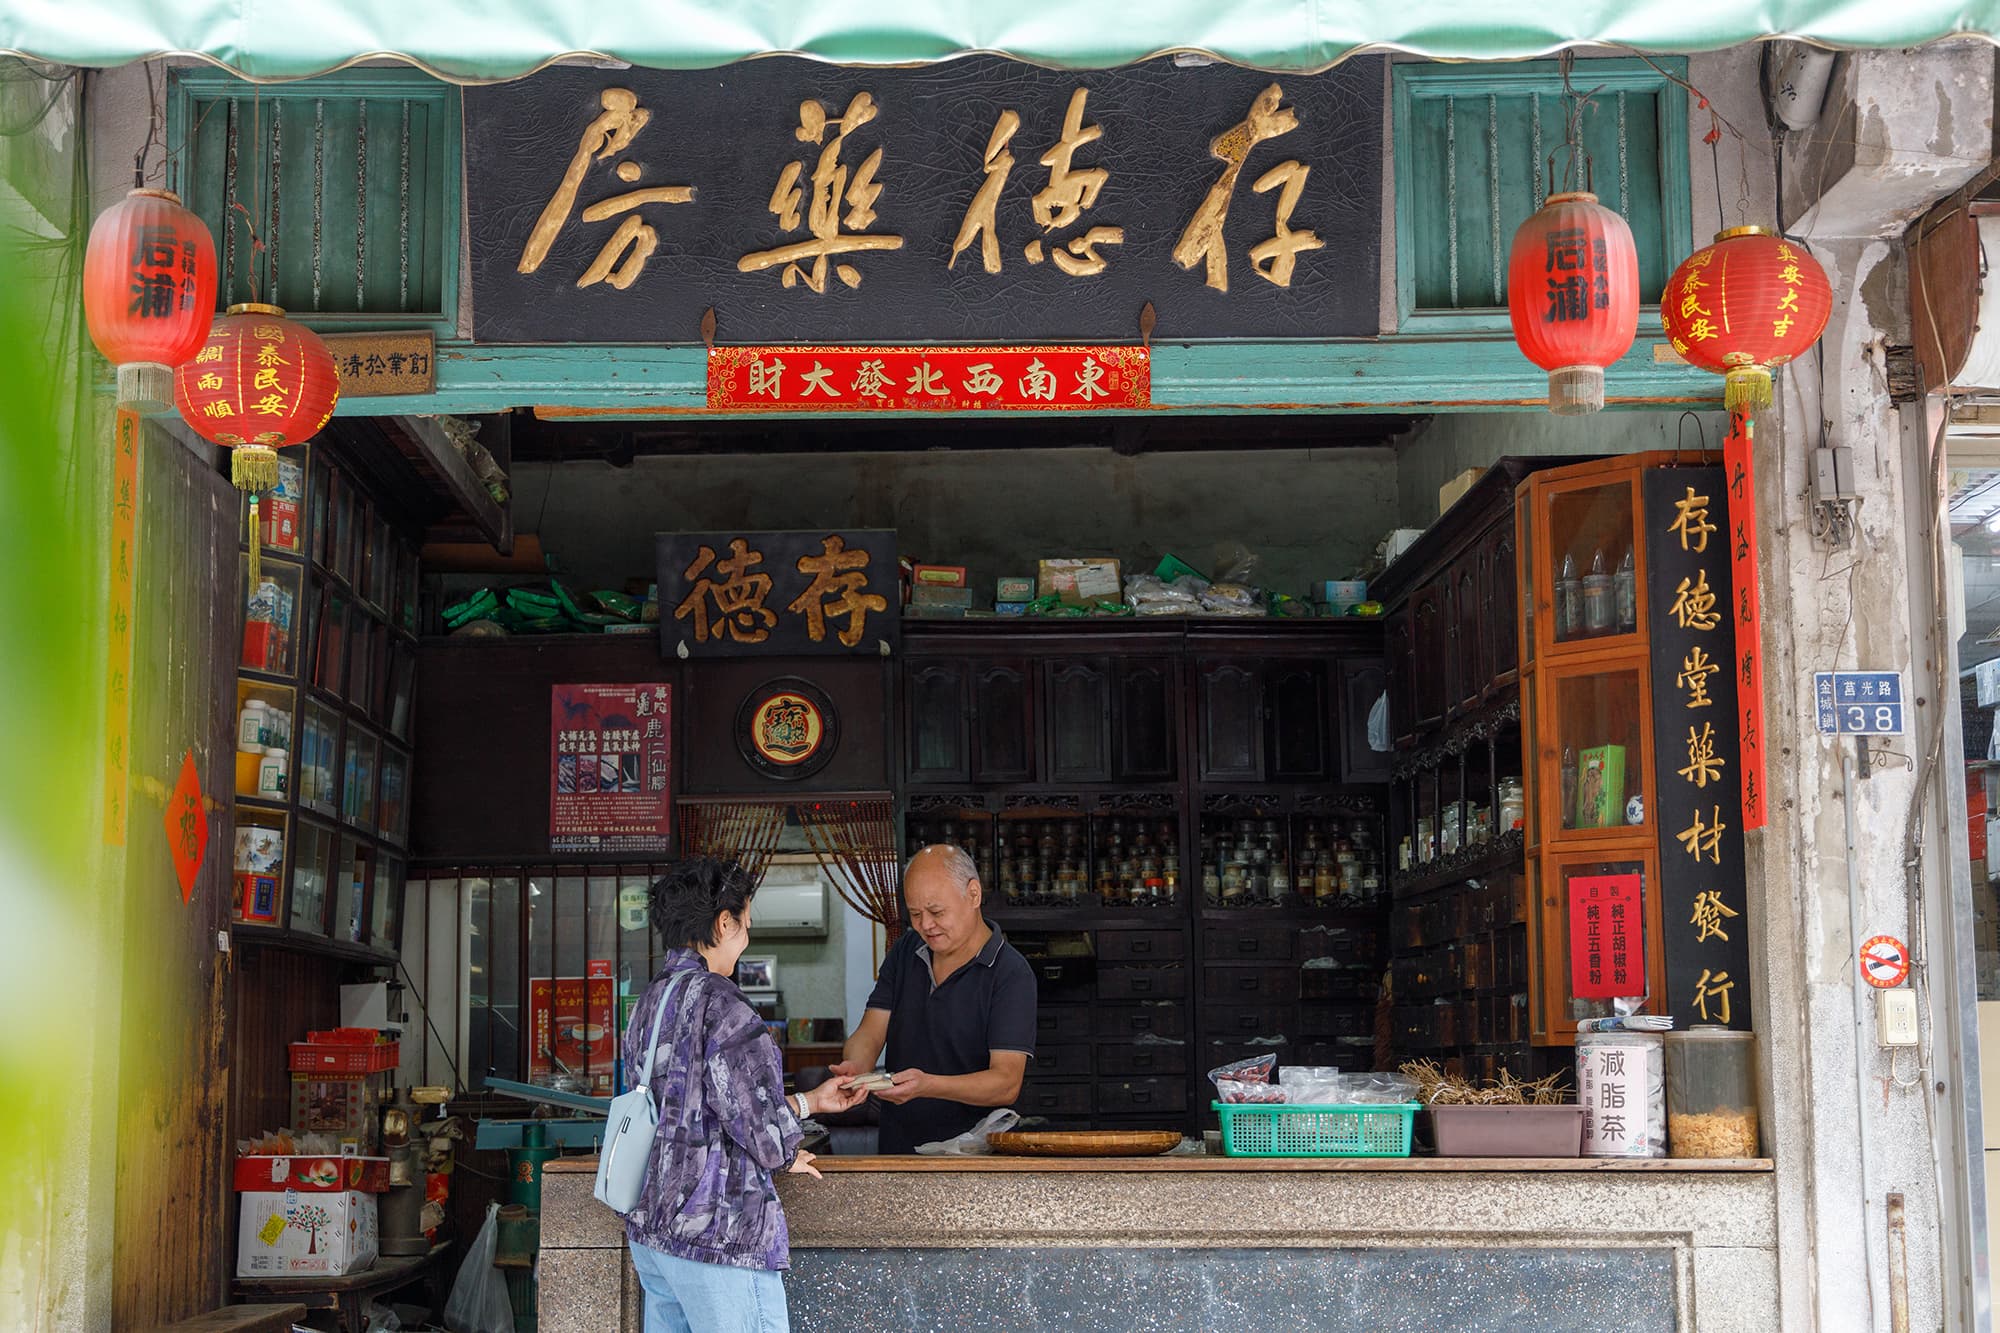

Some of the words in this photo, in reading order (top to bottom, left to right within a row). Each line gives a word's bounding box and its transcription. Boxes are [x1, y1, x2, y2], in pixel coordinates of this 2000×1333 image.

[518, 83, 1325, 292] 存德藥房
[128, 225, 178, 318] 后浦
[1543, 228, 1589, 322] 后浦
[1680, 249, 1718, 341] 國泰民安
[250, 325, 291, 417] 國泰民安
[333, 352, 429, 378] 創業於清
[747, 357, 1109, 401] 東南西北發大財
[674, 535, 888, 647] 存德
[1844, 680, 1892, 697] 莒光路
[1847, 705, 1894, 732] 38
[1667, 486, 1739, 1024] 存德堂藥材發行
[1587, 903, 1601, 986] 純正五香粉
[1611, 903, 1627, 985] 純正胡椒粉
[1600, 1051, 1626, 1141] 減脂茶
